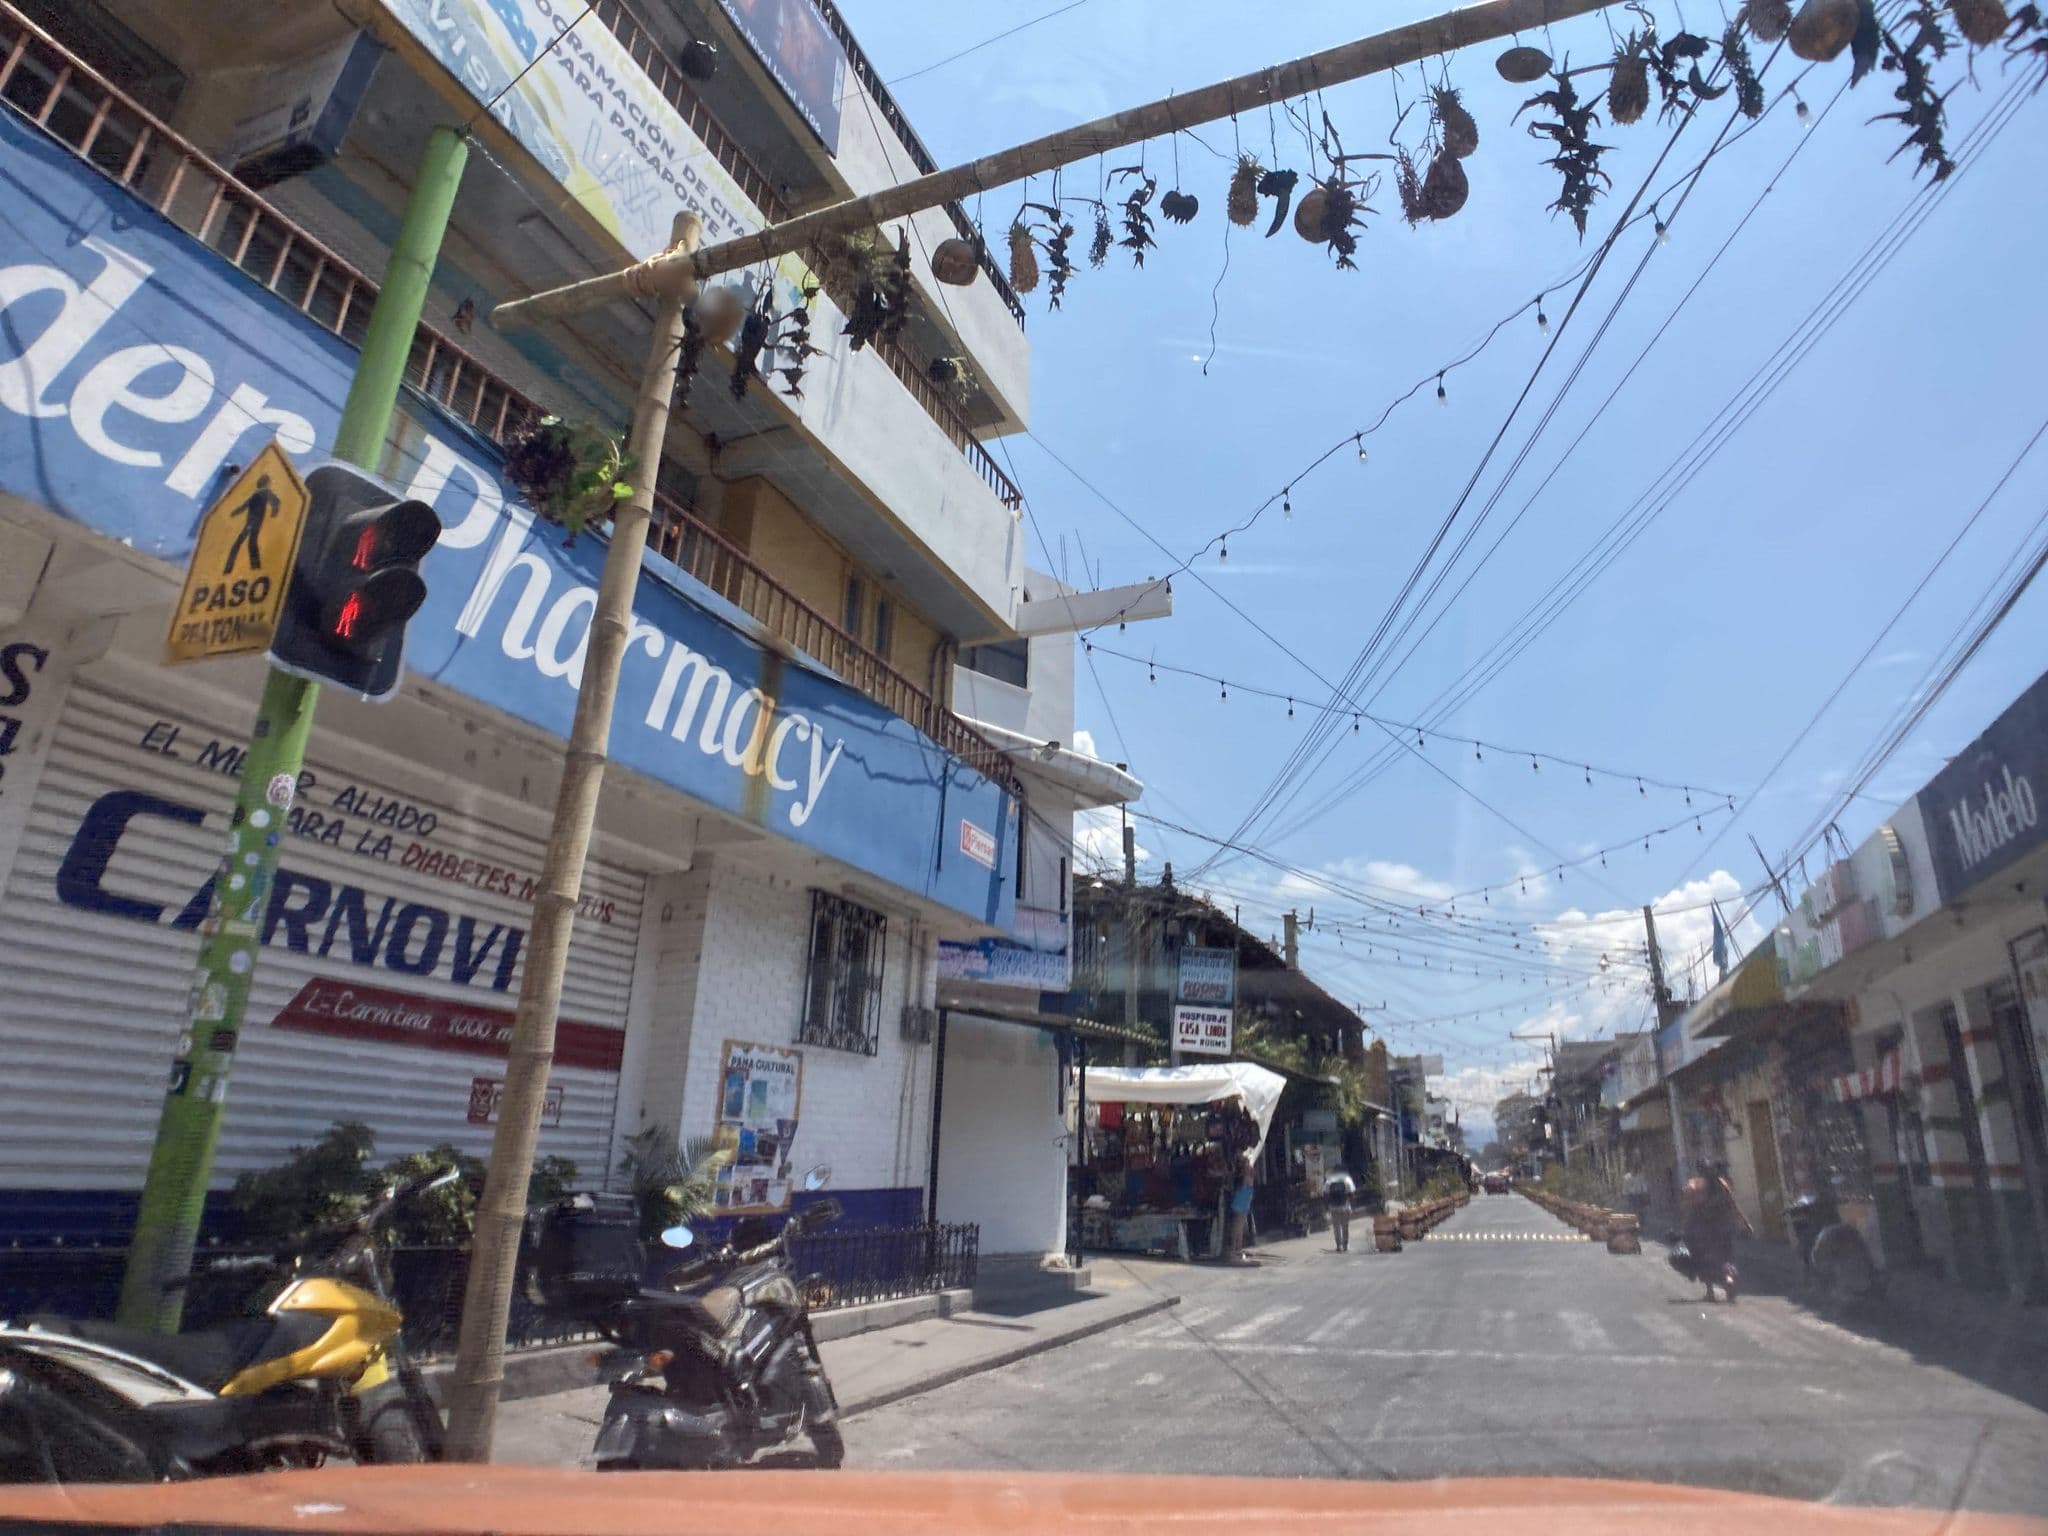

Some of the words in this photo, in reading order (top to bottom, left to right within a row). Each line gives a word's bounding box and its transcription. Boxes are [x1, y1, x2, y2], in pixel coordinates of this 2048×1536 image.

[545, 37, 604, 112] PARA
[610, 110, 721, 238] PASAPORTE
[683, 163, 708, 198] DE
[711, 196, 745, 236] CITA
[189, 576, 271, 614] PASO
[405, 434, 843, 827] Pharmacy
[141, 720, 180, 757] EL
[196, 741, 316, 798] MER
[332, 785, 438, 837] ALIADO
[1949, 764, 2038, 871] Modelo
[287, 806, 345, 846] ARA
[352, 829, 394, 862] LA
[401, 842, 516, 899] DIABETES
[303, 990, 433, 1031] L-Carnitina
[449, 1015, 493, 1041] 1000
